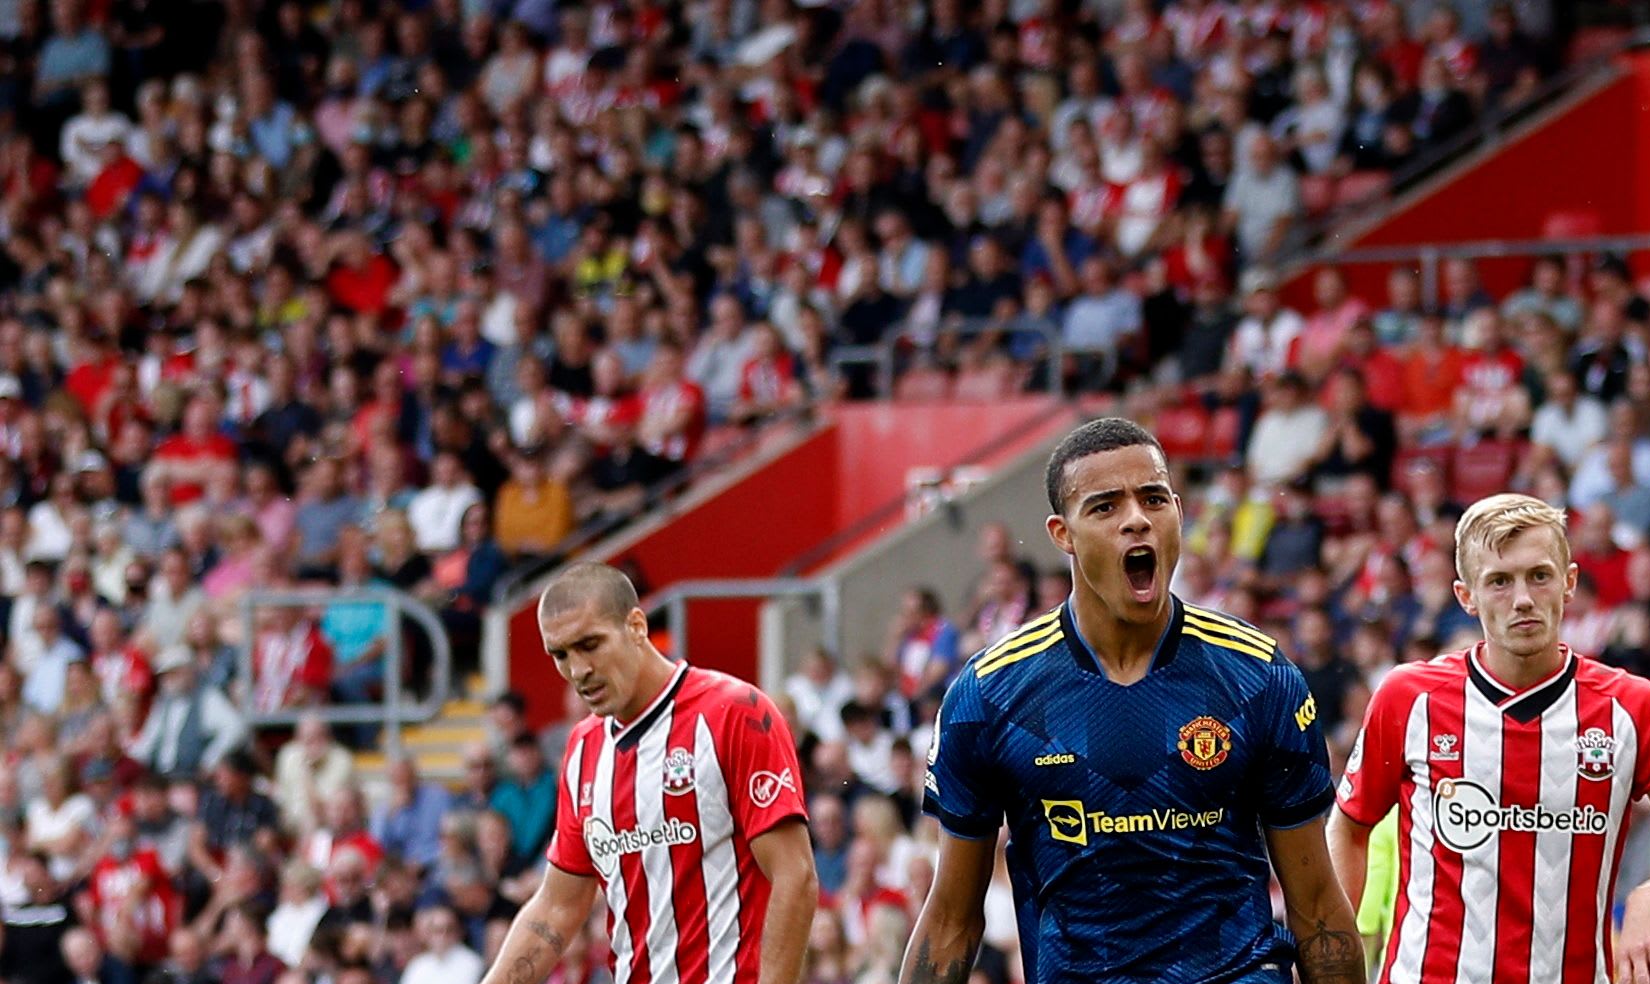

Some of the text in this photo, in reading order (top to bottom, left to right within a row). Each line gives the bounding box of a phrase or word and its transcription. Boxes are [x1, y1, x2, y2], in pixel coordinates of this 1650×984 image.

[1034, 753, 1075, 766] adidas
[1086, 807, 1224, 834] TeamViewer
[1448, 802, 1607, 833] Sportsbet.io
[592, 821, 695, 857] Sportsbet.io
